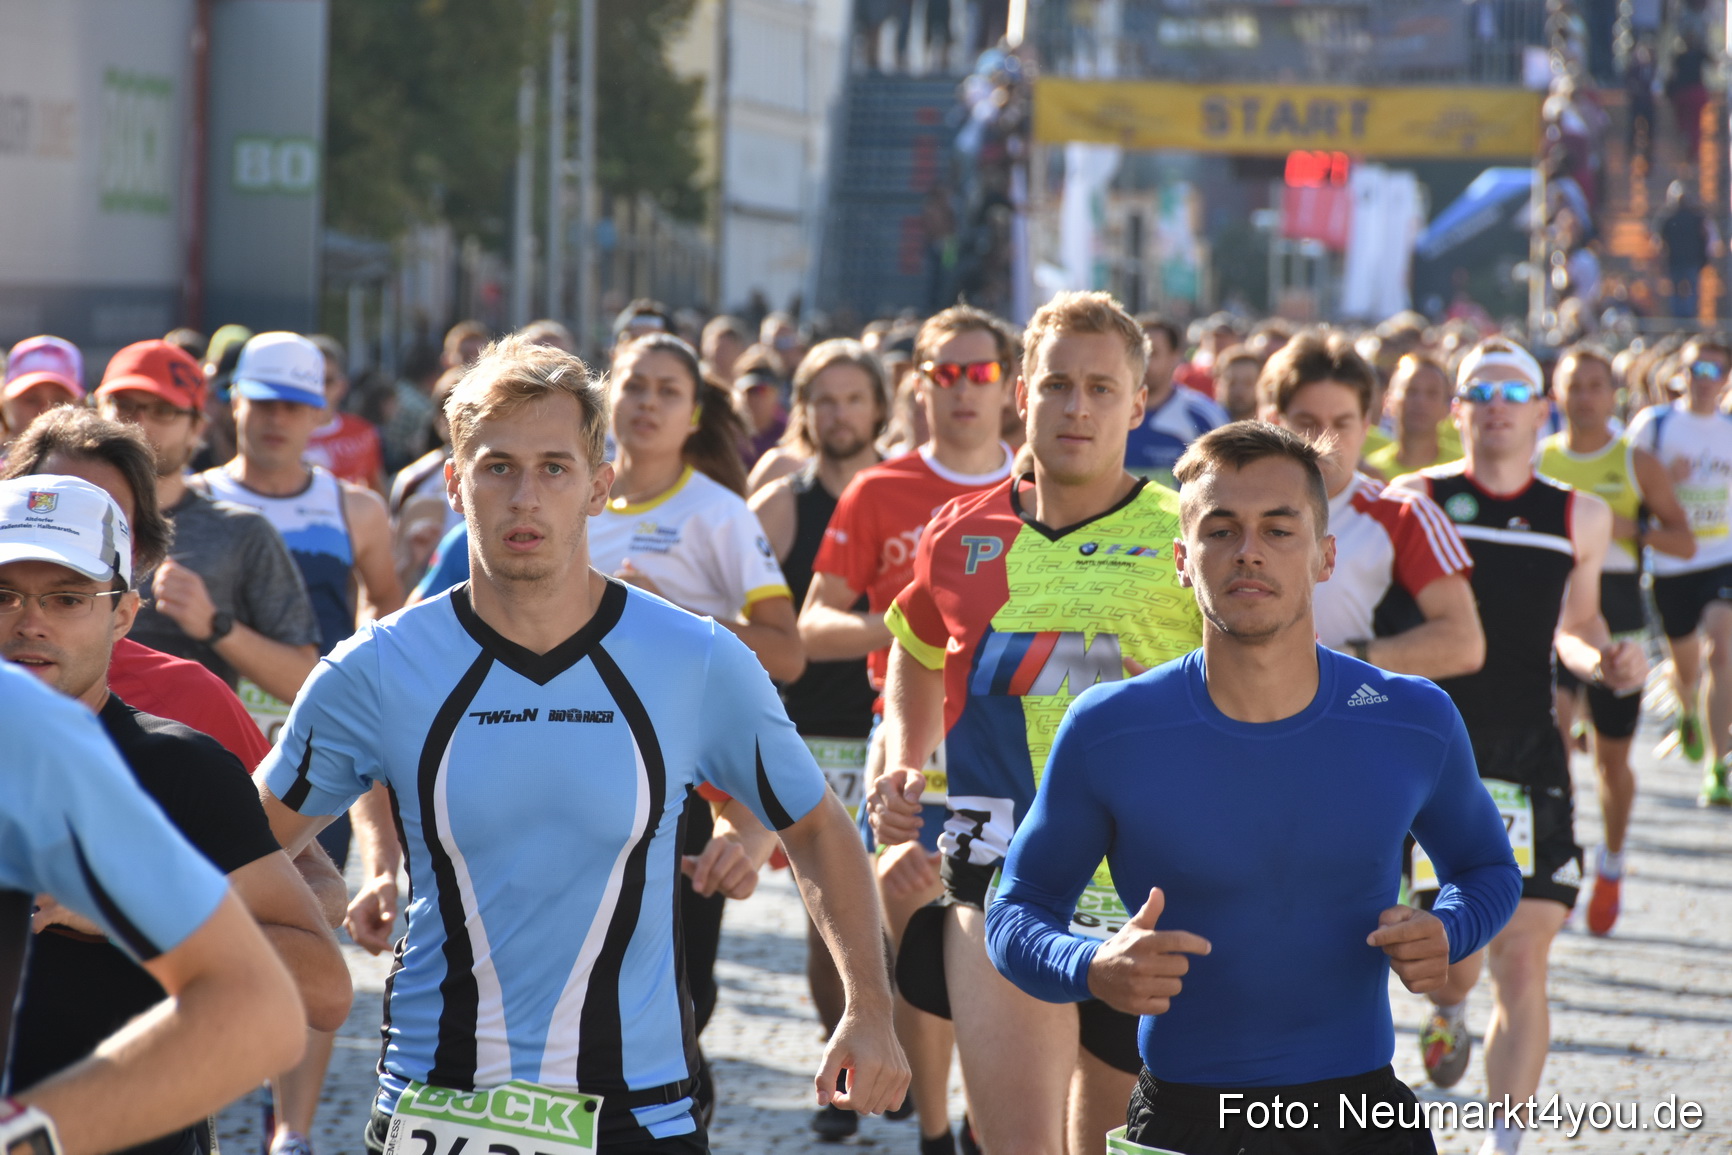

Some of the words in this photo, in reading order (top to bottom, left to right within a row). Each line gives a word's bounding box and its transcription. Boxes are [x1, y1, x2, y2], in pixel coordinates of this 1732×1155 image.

[1202, 95, 1370, 139] START
[37, 523, 80, 536] Halbmarathon
[1347, 694, 1389, 707] adidas
